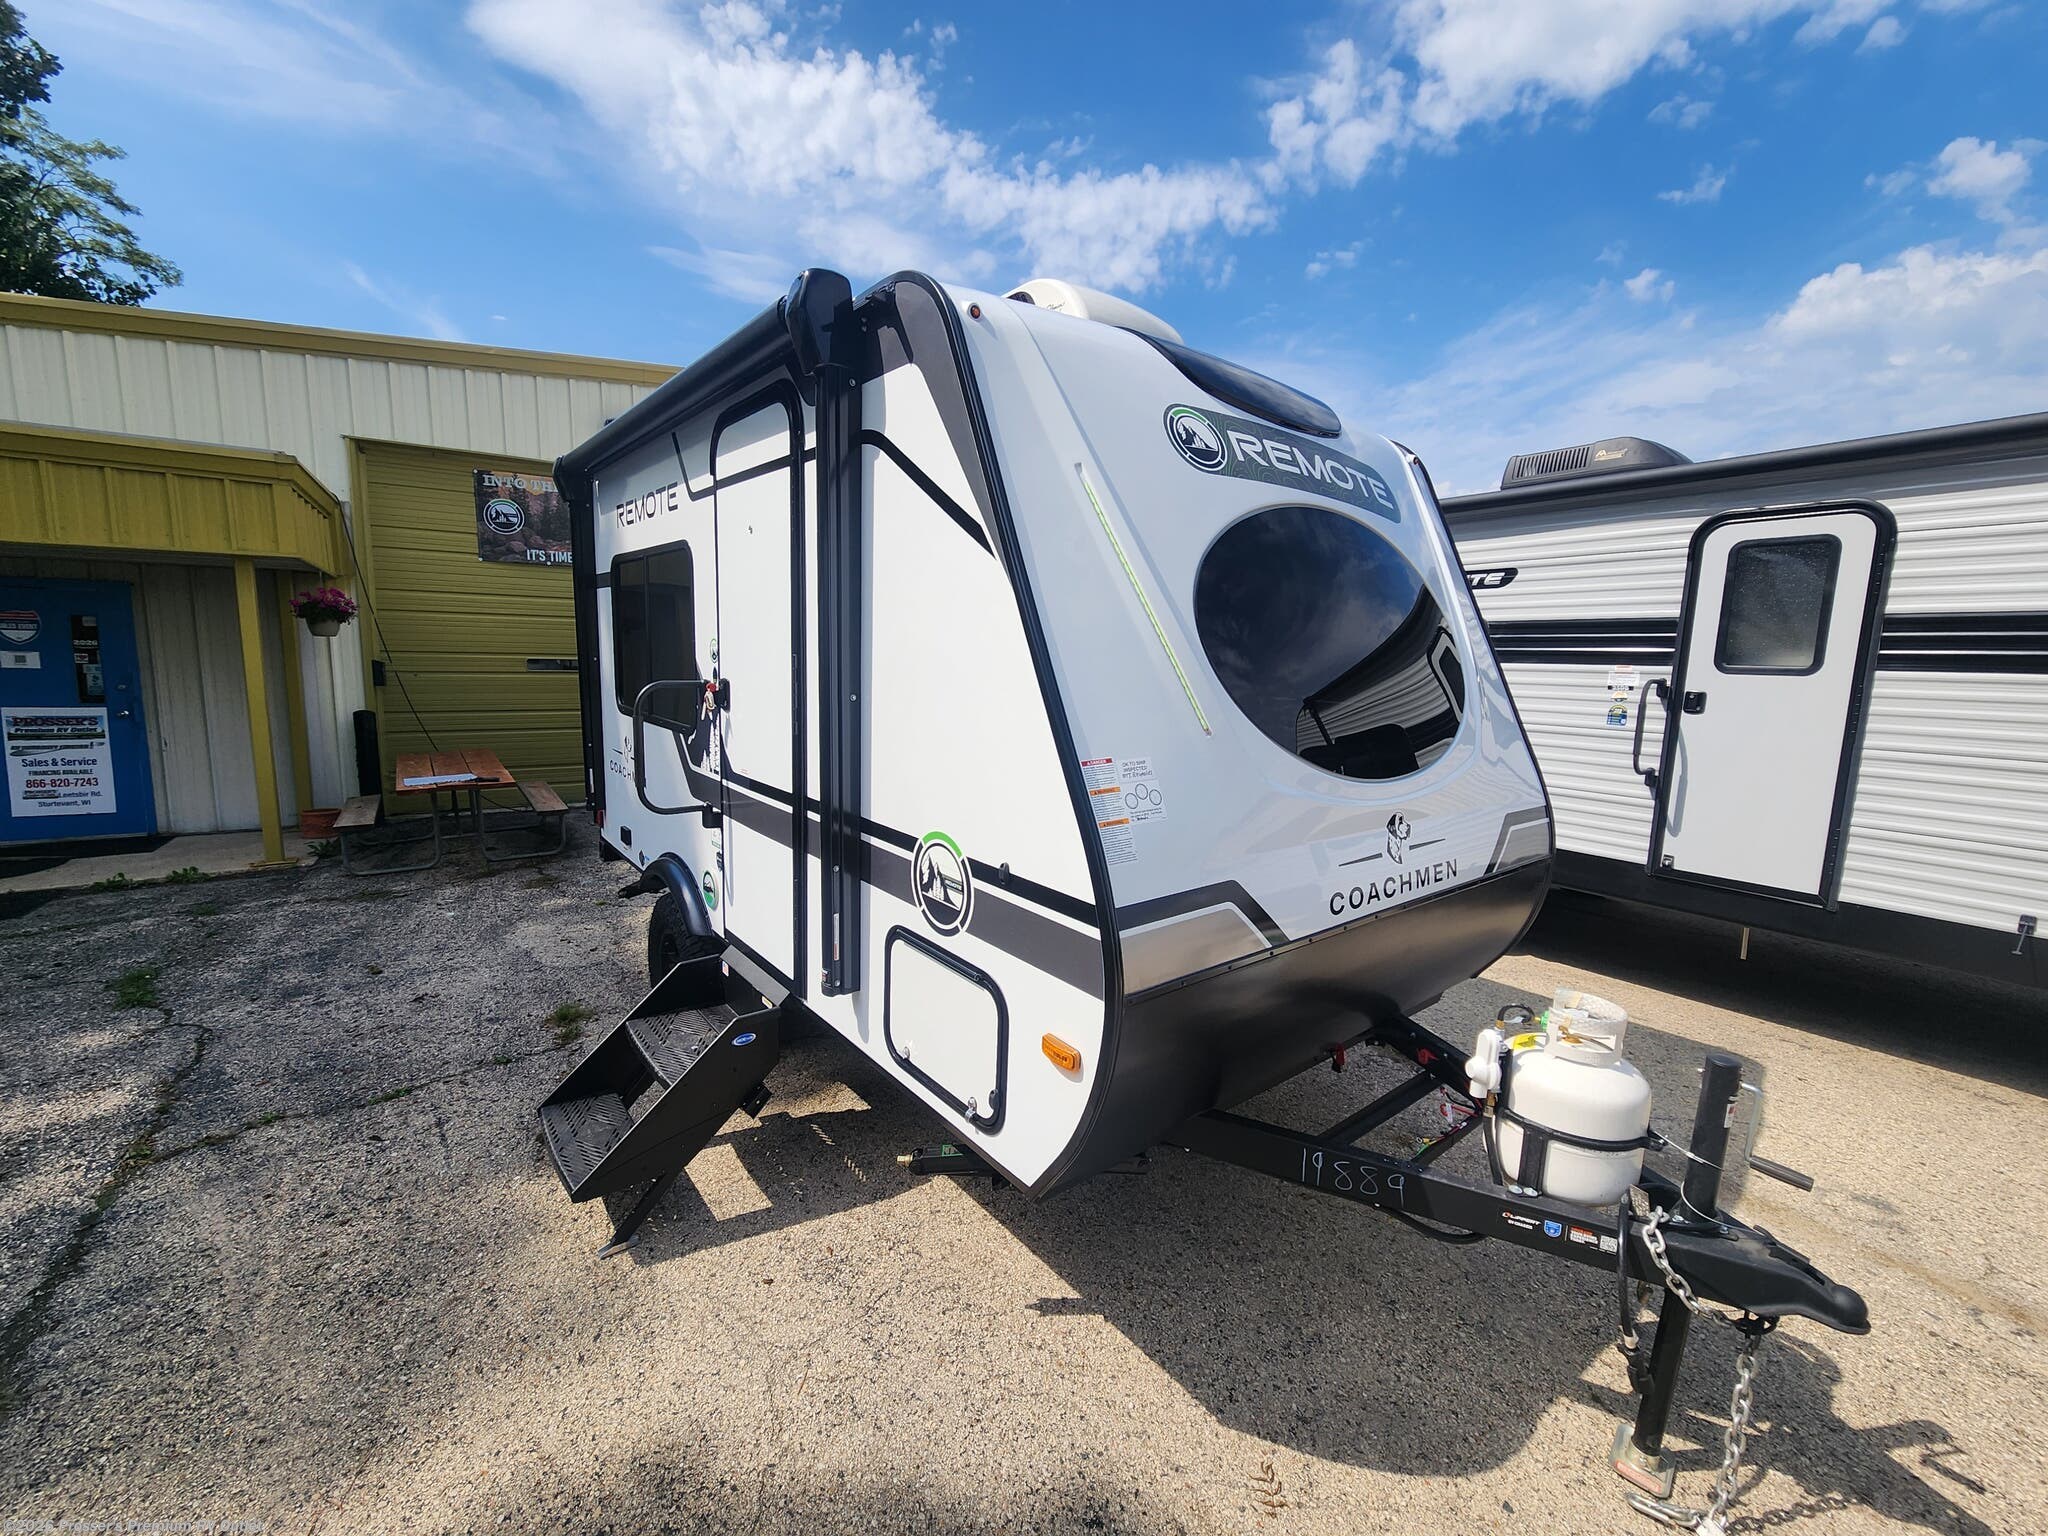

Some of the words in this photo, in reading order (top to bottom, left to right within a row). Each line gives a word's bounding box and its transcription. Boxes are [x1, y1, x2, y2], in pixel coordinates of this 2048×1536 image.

[1226, 430, 1394, 510] REMOTE
[482, 474, 527, 489] INTO
[616, 481, 679, 529] REMOTE
[526, 549, 546, 562] IT'S
[550, 551, 573, 563] TIME
[1467, 572, 1506, 586] TE
[12, 717, 99, 727] PROSSER'S
[21, 758, 50, 767] Sales
[51, 757, 59, 766] &
[61, 756, 98, 766] Service
[609, 759, 635, 781] COACH
[26, 777, 99, 789] 866-820-7243
[1329, 858, 1458, 916] COACHMEN
[1302, 1147, 1405, 1208] 19889
